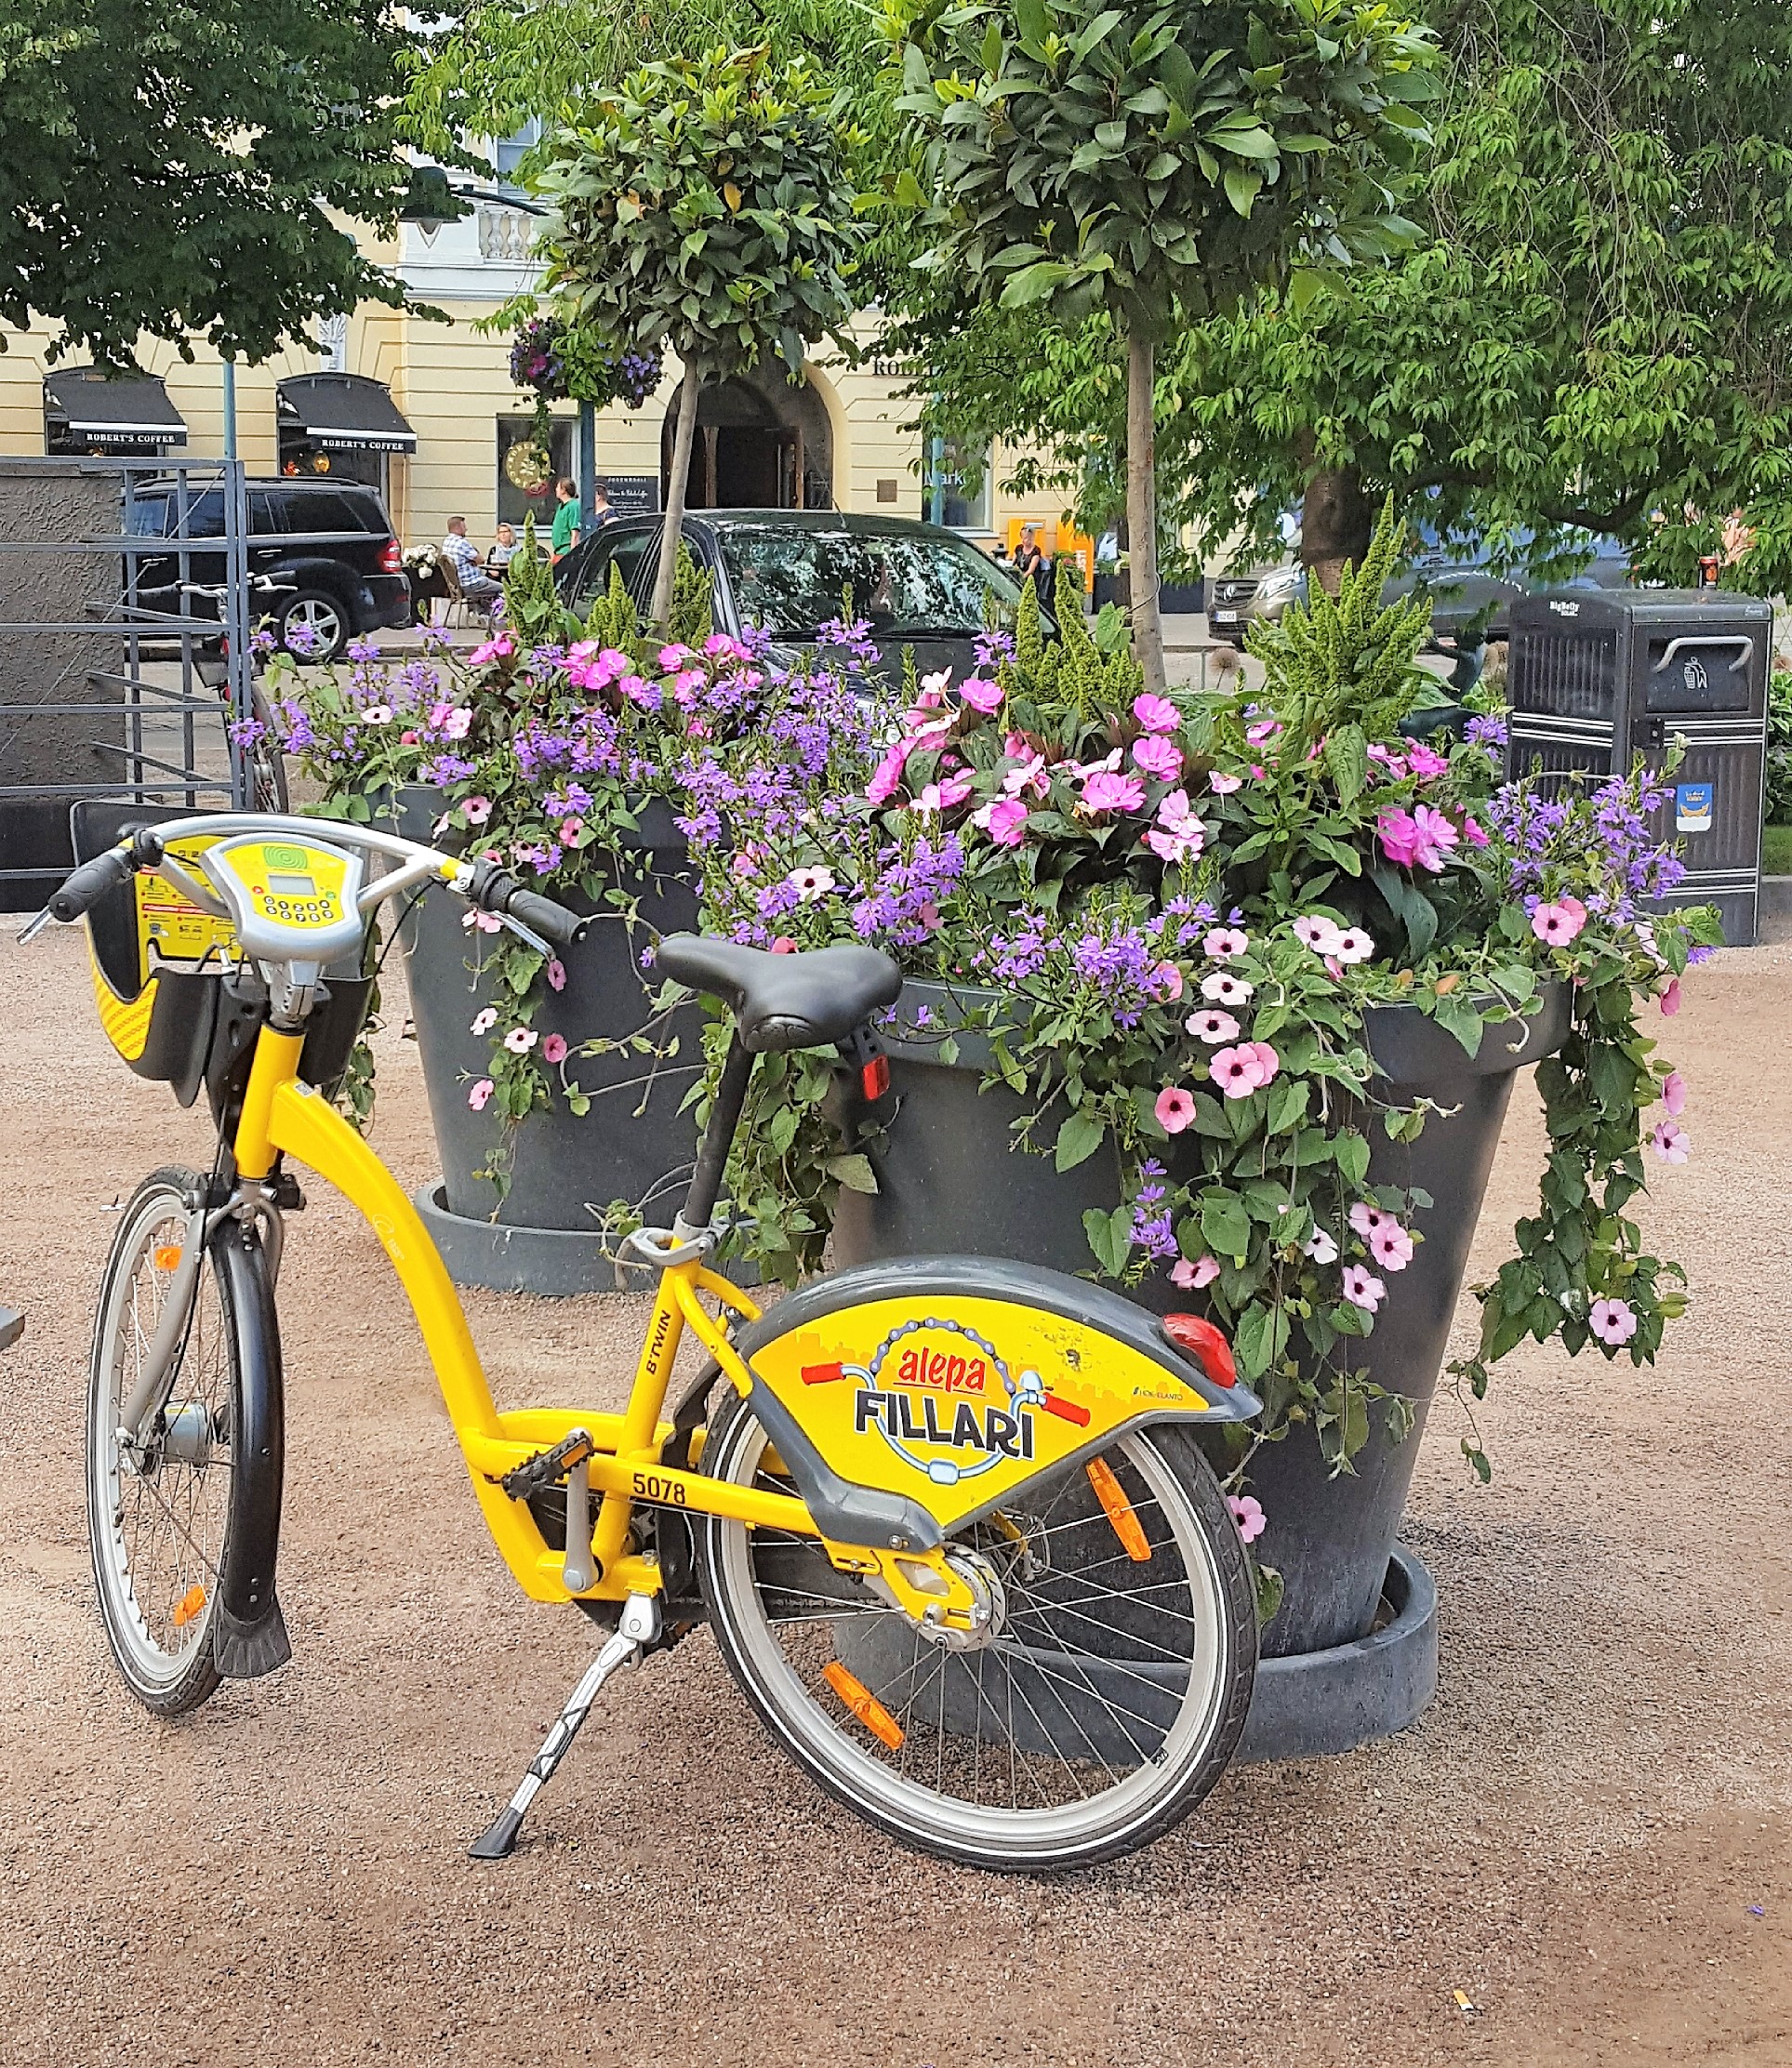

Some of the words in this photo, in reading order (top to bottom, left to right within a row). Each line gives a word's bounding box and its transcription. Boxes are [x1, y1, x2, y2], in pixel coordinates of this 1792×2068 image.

[86, 432, 135, 443] ROBERT'S
[137, 434, 176, 444] COFFEE
[321, 439, 366, 449] ROBERT'S
[368, 441, 405, 451] COFFEE
[898, 1346, 986, 1393] alepa
[855, 1388, 1034, 1460] FILLARI
[633, 1473, 685, 1505] 5078
